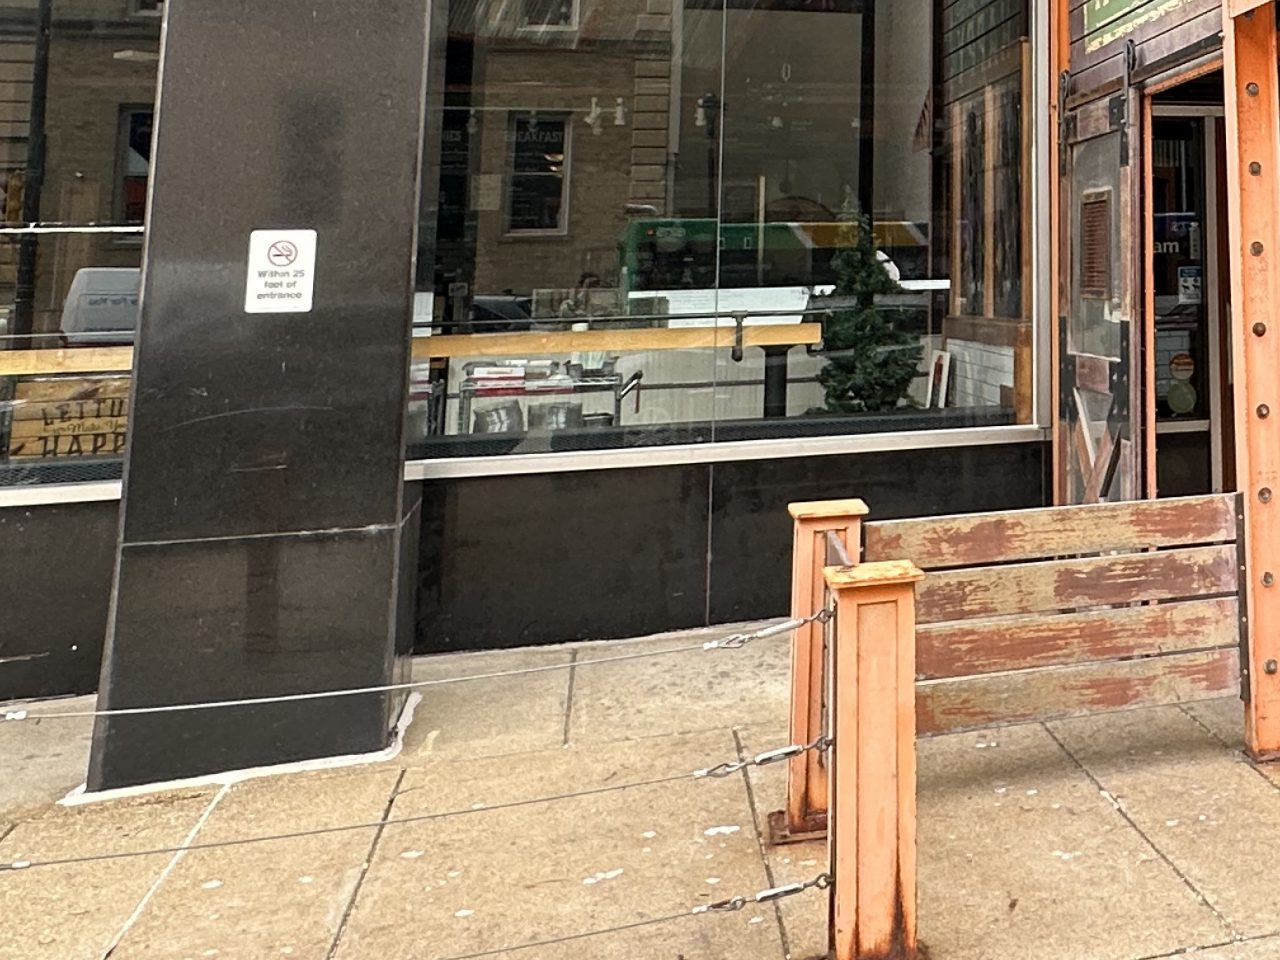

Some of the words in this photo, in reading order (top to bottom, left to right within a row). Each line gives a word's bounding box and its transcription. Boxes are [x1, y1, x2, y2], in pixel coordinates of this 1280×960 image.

[257, 270, 290, 278] Within
[292, 269, 305, 278] 25
[286, 280, 297, 289] of
[257, 292, 303, 300] entrance
